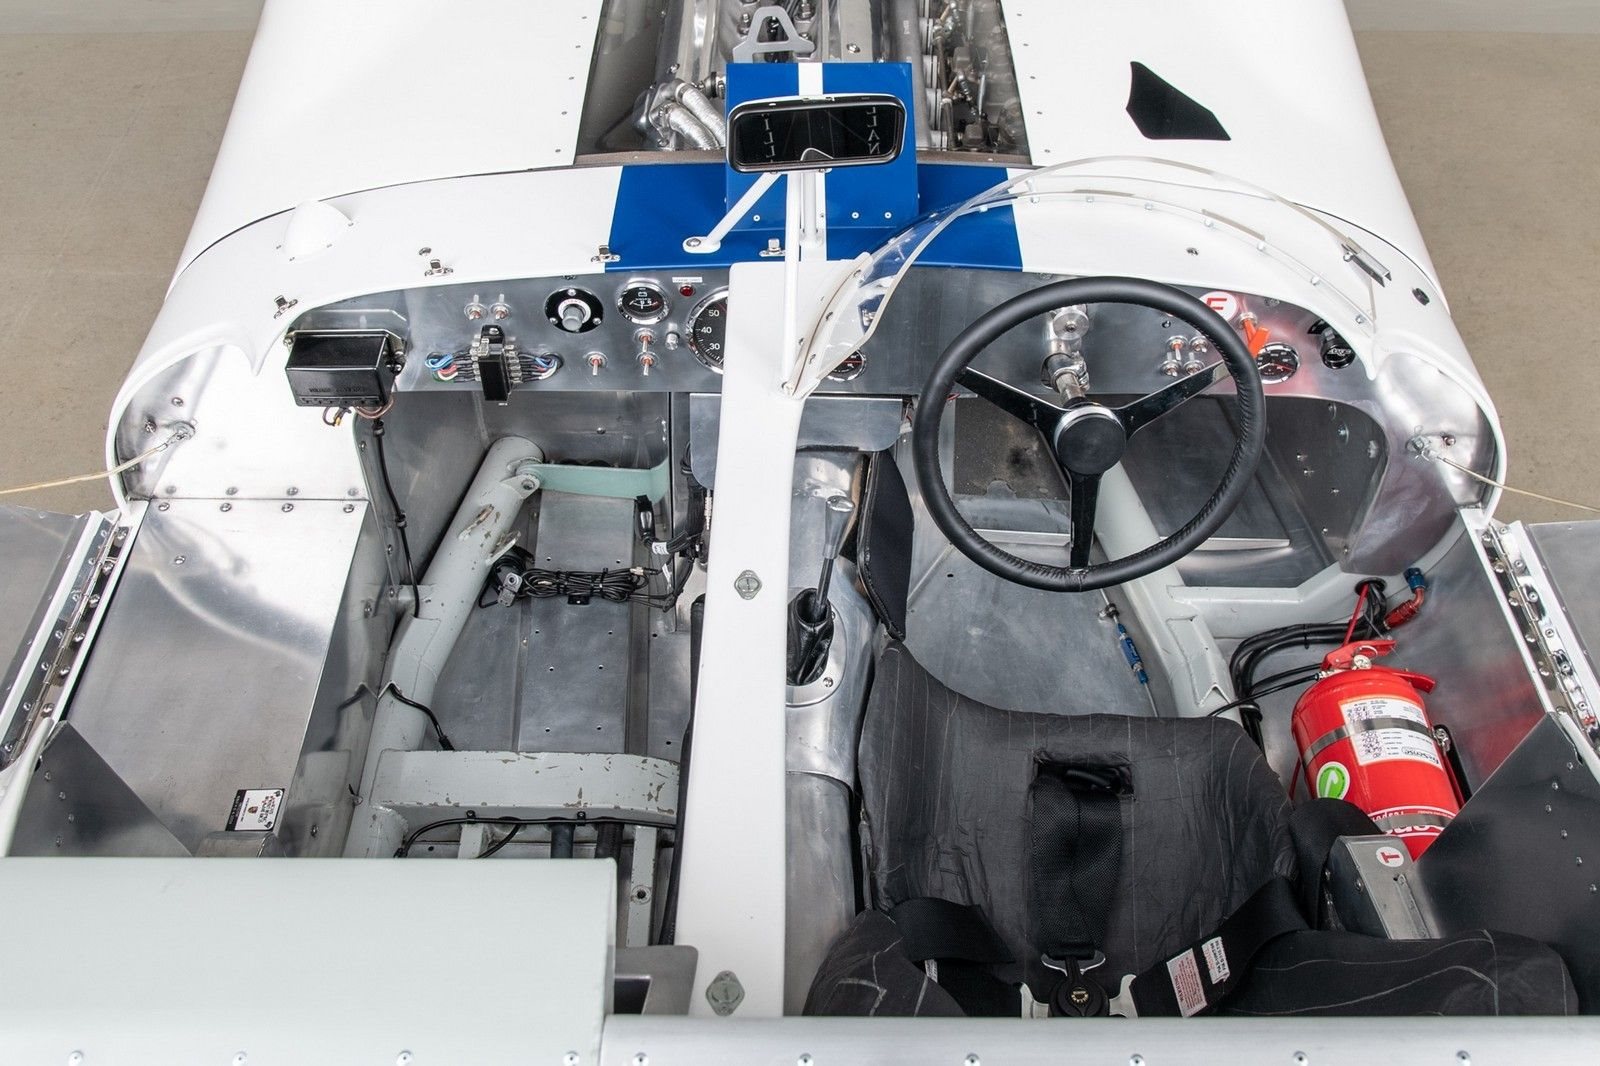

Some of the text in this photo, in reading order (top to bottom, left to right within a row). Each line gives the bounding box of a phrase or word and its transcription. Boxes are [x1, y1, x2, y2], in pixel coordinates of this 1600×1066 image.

[708, 309, 720, 317] 50
[700, 326, 712, 334] 40
[1380, 851, 1400, 864] T
